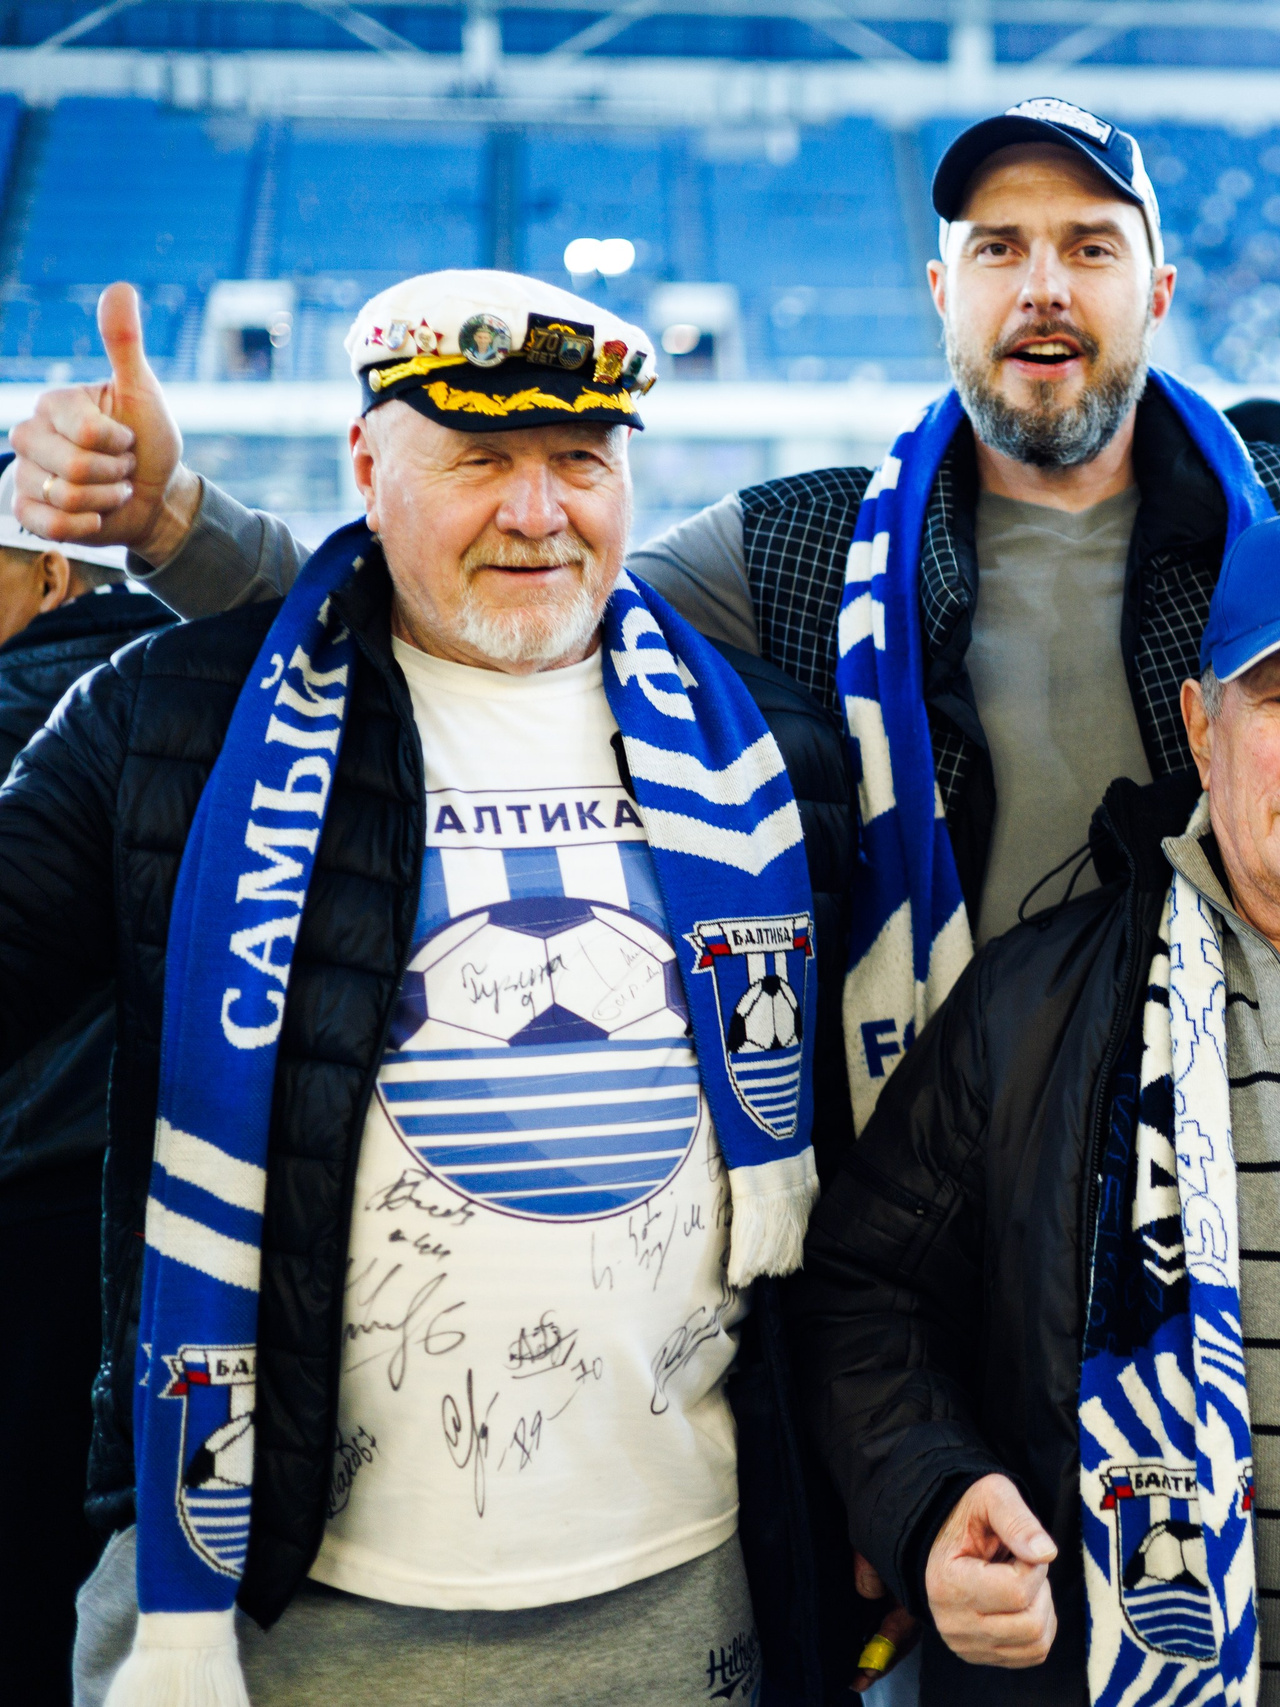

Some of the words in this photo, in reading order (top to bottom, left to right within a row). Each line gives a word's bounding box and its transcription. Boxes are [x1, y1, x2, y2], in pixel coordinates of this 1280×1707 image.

[433, 799, 644, 836] АЛТИКА
[220, 644, 349, 1050] САМЫЙ
[731, 926, 792, 946] БАЛТИКА
[1134, 1472, 1198, 1492] БАЛТИ
